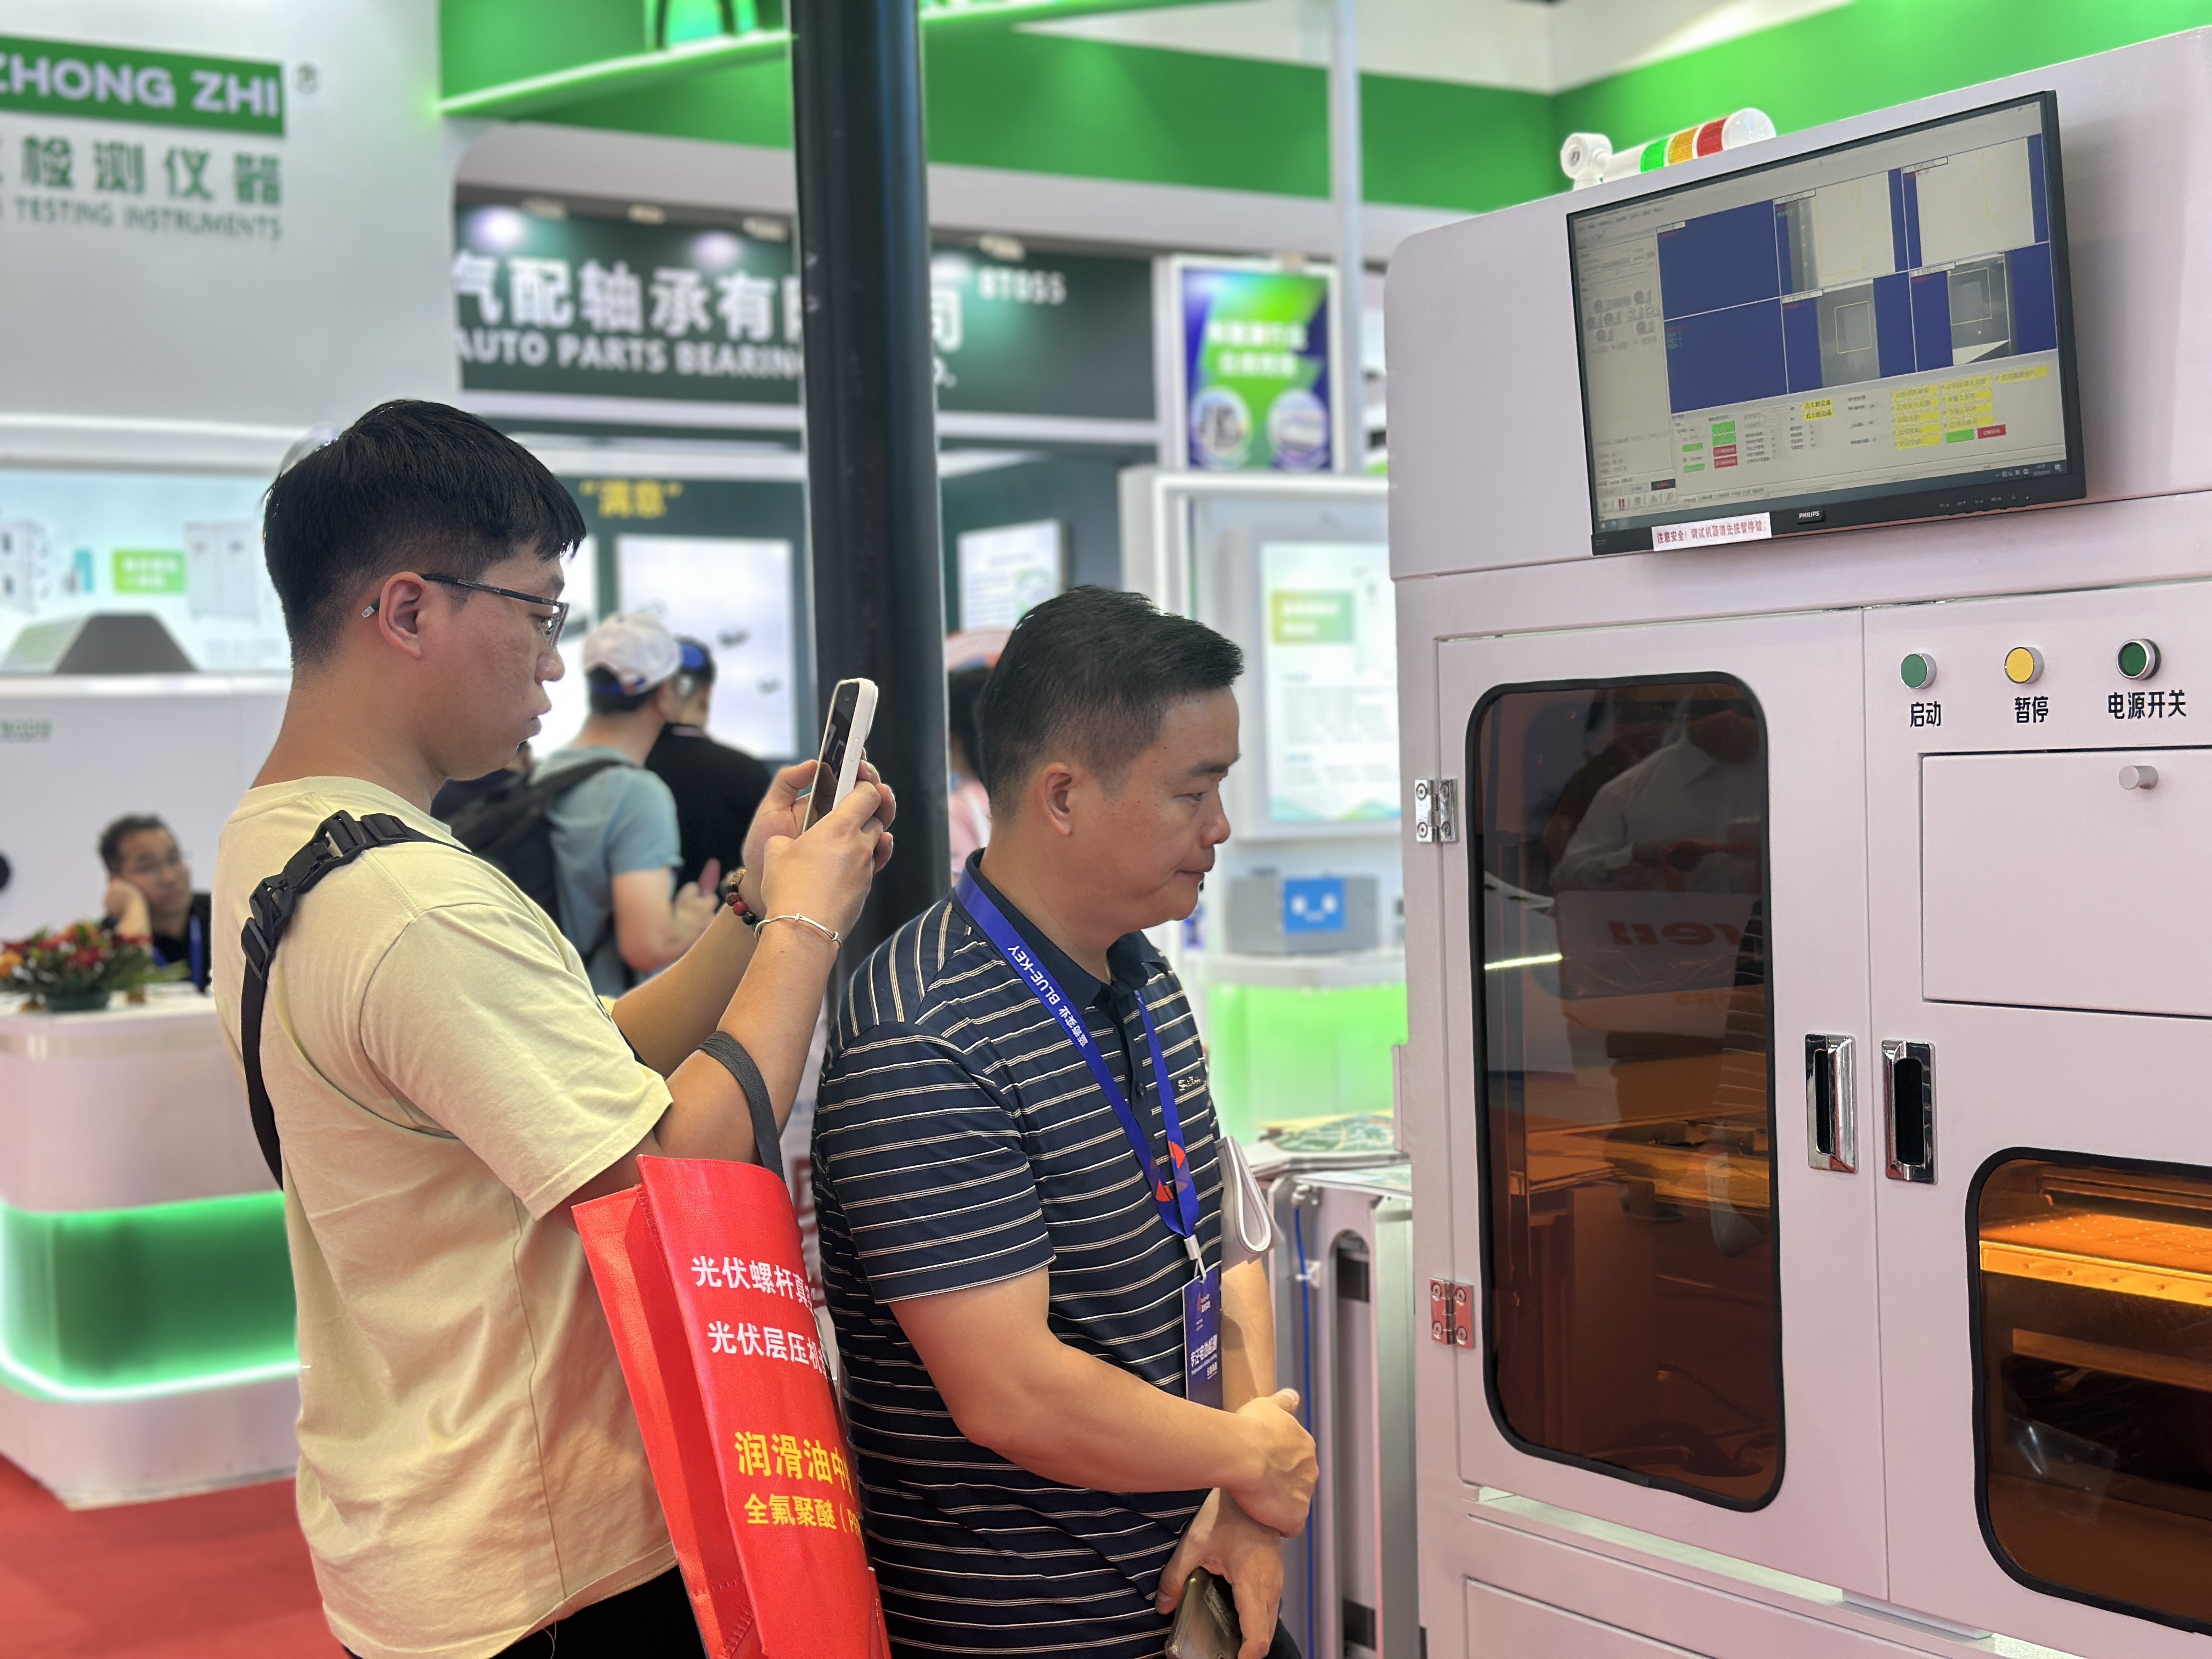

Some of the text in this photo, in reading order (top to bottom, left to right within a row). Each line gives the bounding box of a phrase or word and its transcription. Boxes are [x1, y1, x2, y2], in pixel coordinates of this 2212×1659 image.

[0, 52, 279, 117] HONG ZHI
[0, 135, 281, 205] 检测仪器
[14, 196, 114, 227] TESTING
[124, 207, 282, 240] INSTRUMENTS
[556, 334, 668, 374] PARTS
[674, 341, 803, 380] BEARIN
[1799, 510, 1819, 519] PHILIPS
[1910, 701, 1942, 727] 启动
[2014, 696, 2049, 724] 暂停
[2108, 689, 2187, 720] 电源开关
[1007, 945, 1061, 1006] BLUE-KEY
[734, 1431, 855, 1504] 润滑油中
